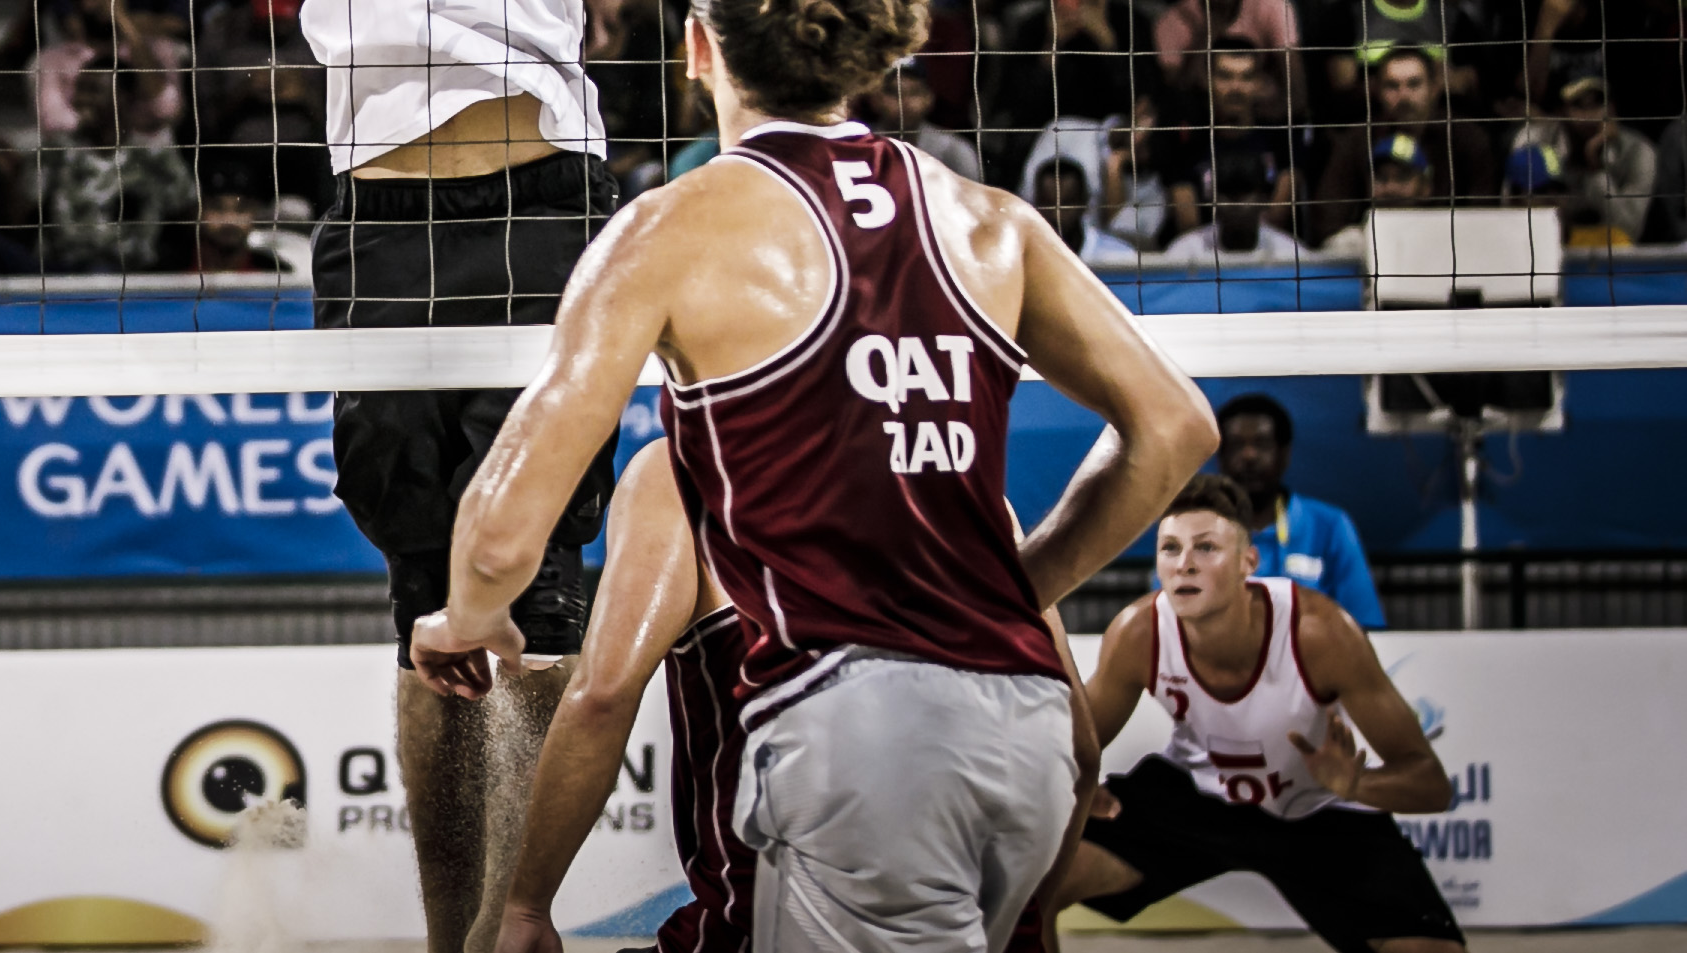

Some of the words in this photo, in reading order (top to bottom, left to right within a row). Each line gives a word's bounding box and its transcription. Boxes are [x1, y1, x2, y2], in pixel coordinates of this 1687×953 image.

[832, 161, 896, 229] 5
[846, 334, 974, 414] QAT
[18, 439, 344, 519] GAMES
